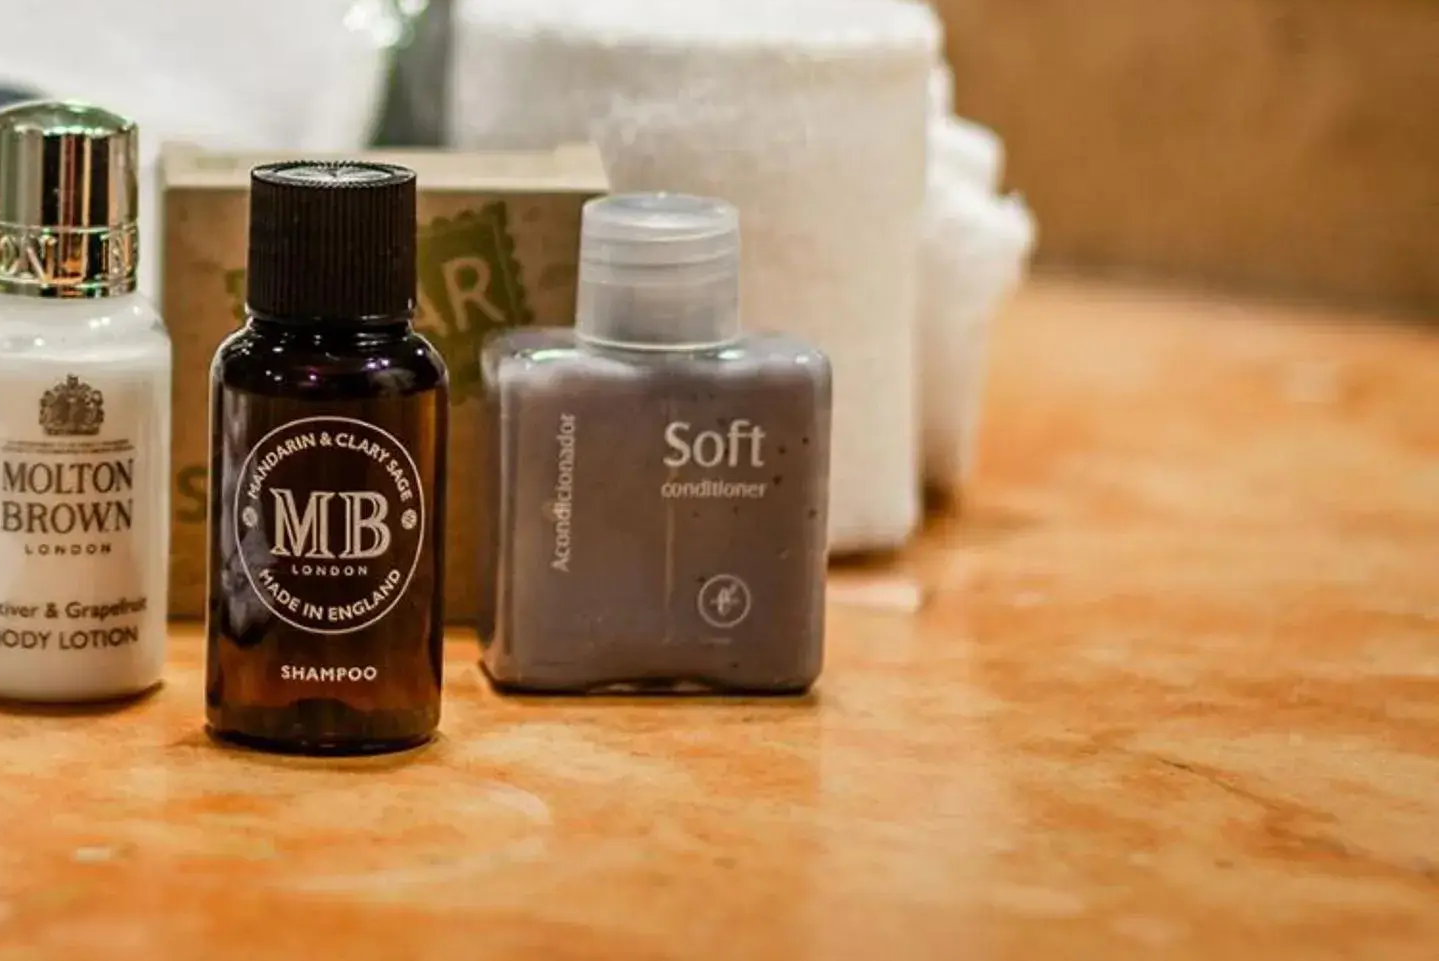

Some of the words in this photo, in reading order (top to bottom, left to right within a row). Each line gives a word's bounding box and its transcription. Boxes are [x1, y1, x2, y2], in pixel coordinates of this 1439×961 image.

[662, 419, 767, 468] Soft
[2, 458, 135, 494] MOLTON
[248, 432, 316, 500] MANDARIN
[319, 431, 333, 447] &
[334, 432, 390, 463] CLARY
[385, 459, 414, 502] SAGE
[550, 413, 577, 573] Acondicionador
[661, 479, 768, 499] conditioner
[0, 498, 134, 535] BROWN
[269, 487, 392, 559] MB
[24, 542, 113, 556] LONDON
[290, 564, 369, 577] LONDON
[45, 602, 59, 620] &
[65, 595, 148, 622] Grapefruit
[259, 568, 300, 611] MADE
[303, 603, 324, 621] IN
[327, 568, 402, 622] ENGLAND
[58, 625, 140, 651] LOTION
[280, 664, 378, 682] SHAMPOO
